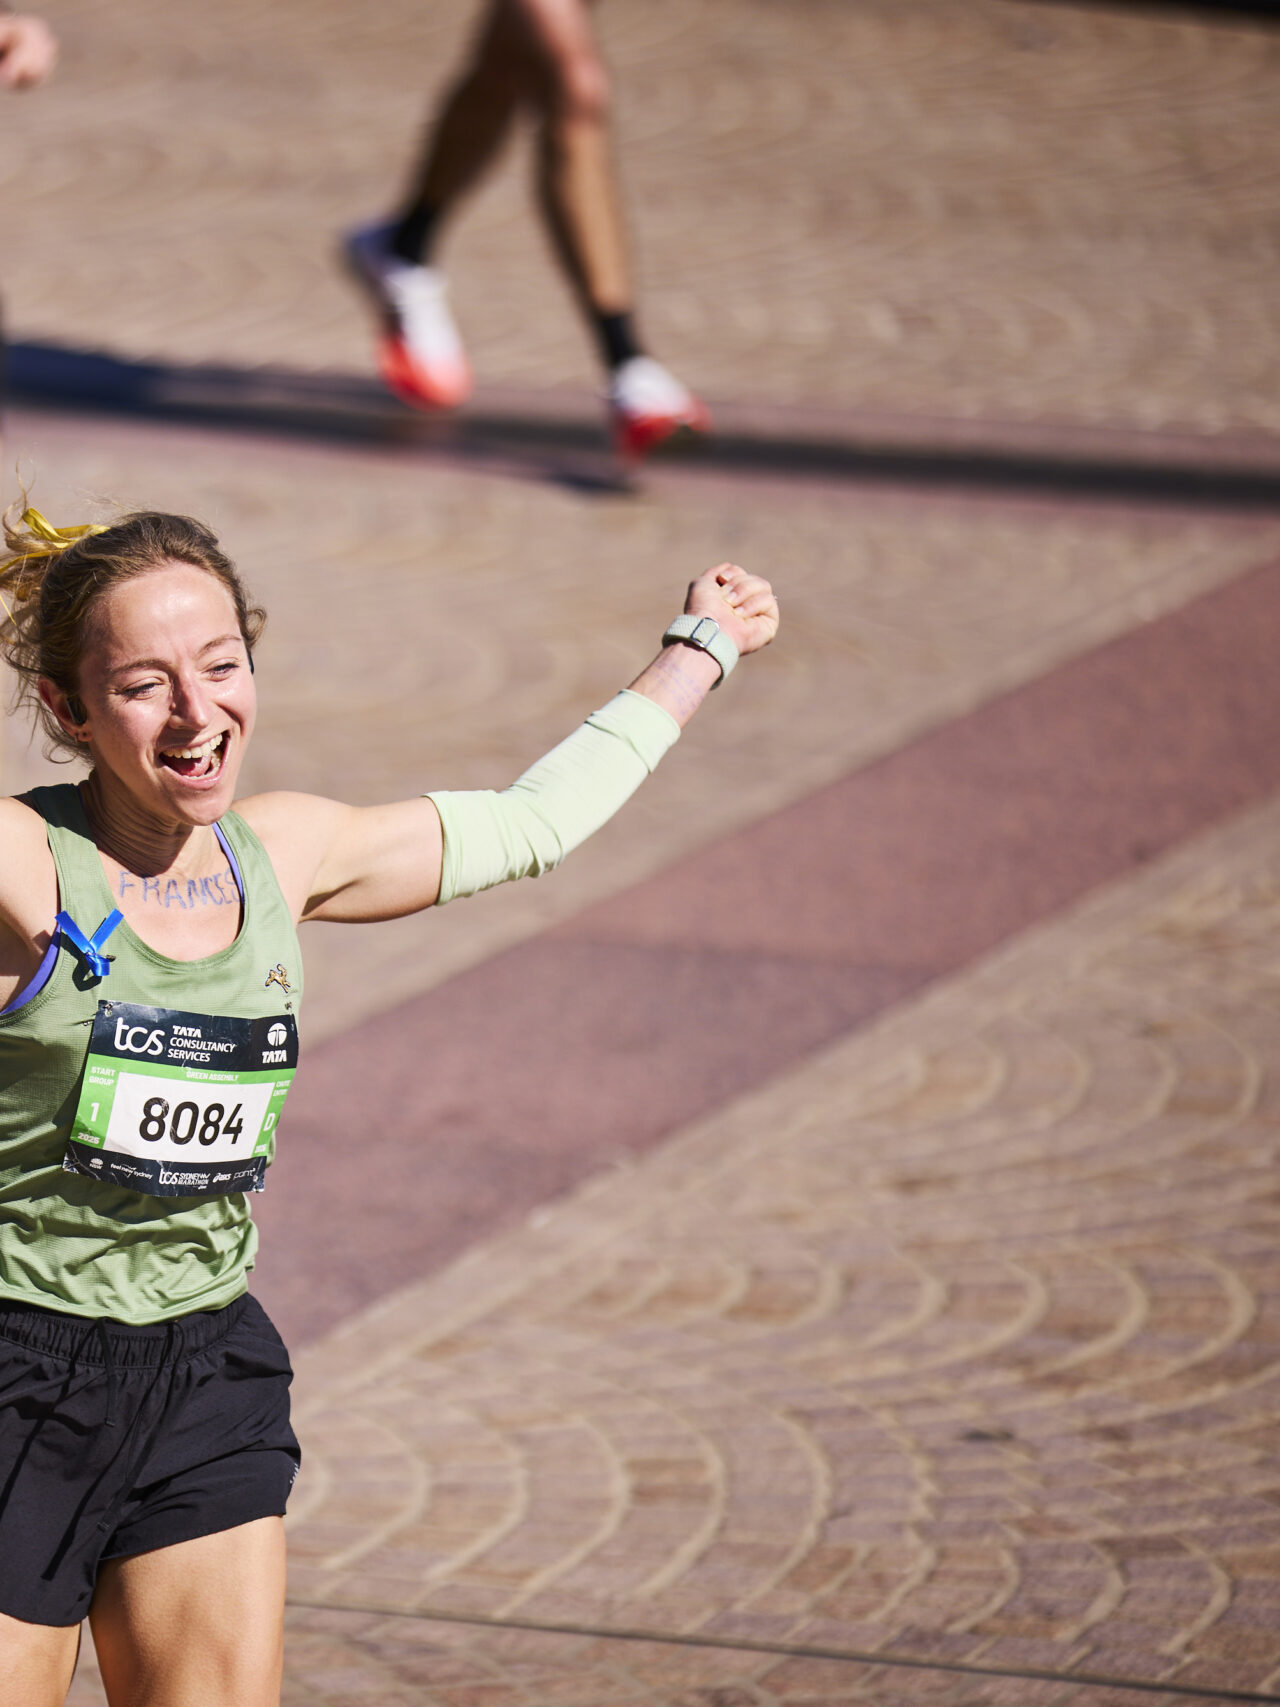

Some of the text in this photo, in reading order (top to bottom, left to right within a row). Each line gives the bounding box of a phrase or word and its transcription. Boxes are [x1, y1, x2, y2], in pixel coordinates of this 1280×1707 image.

[119, 867, 241, 909] FRANCES
[114, 1017, 166, 1056] tcs
[172, 1025, 202, 1039] TATA
[169, 1037, 236, 1053] CONSULTANCY
[167, 1048, 211, 1063] SERVICES
[262, 1050, 287, 1064] TATA
[91, 1066, 116, 1077] START
[186, 1070, 239, 1082] GREEN ASSEMBLY
[88, 1075, 114, 1086] GROUP
[90, 1102, 100, 1122] 1
[138, 1097, 243, 1146] 8084
[263, 1113, 276, 1131] D
[158, 1168, 179, 1184] tcs
